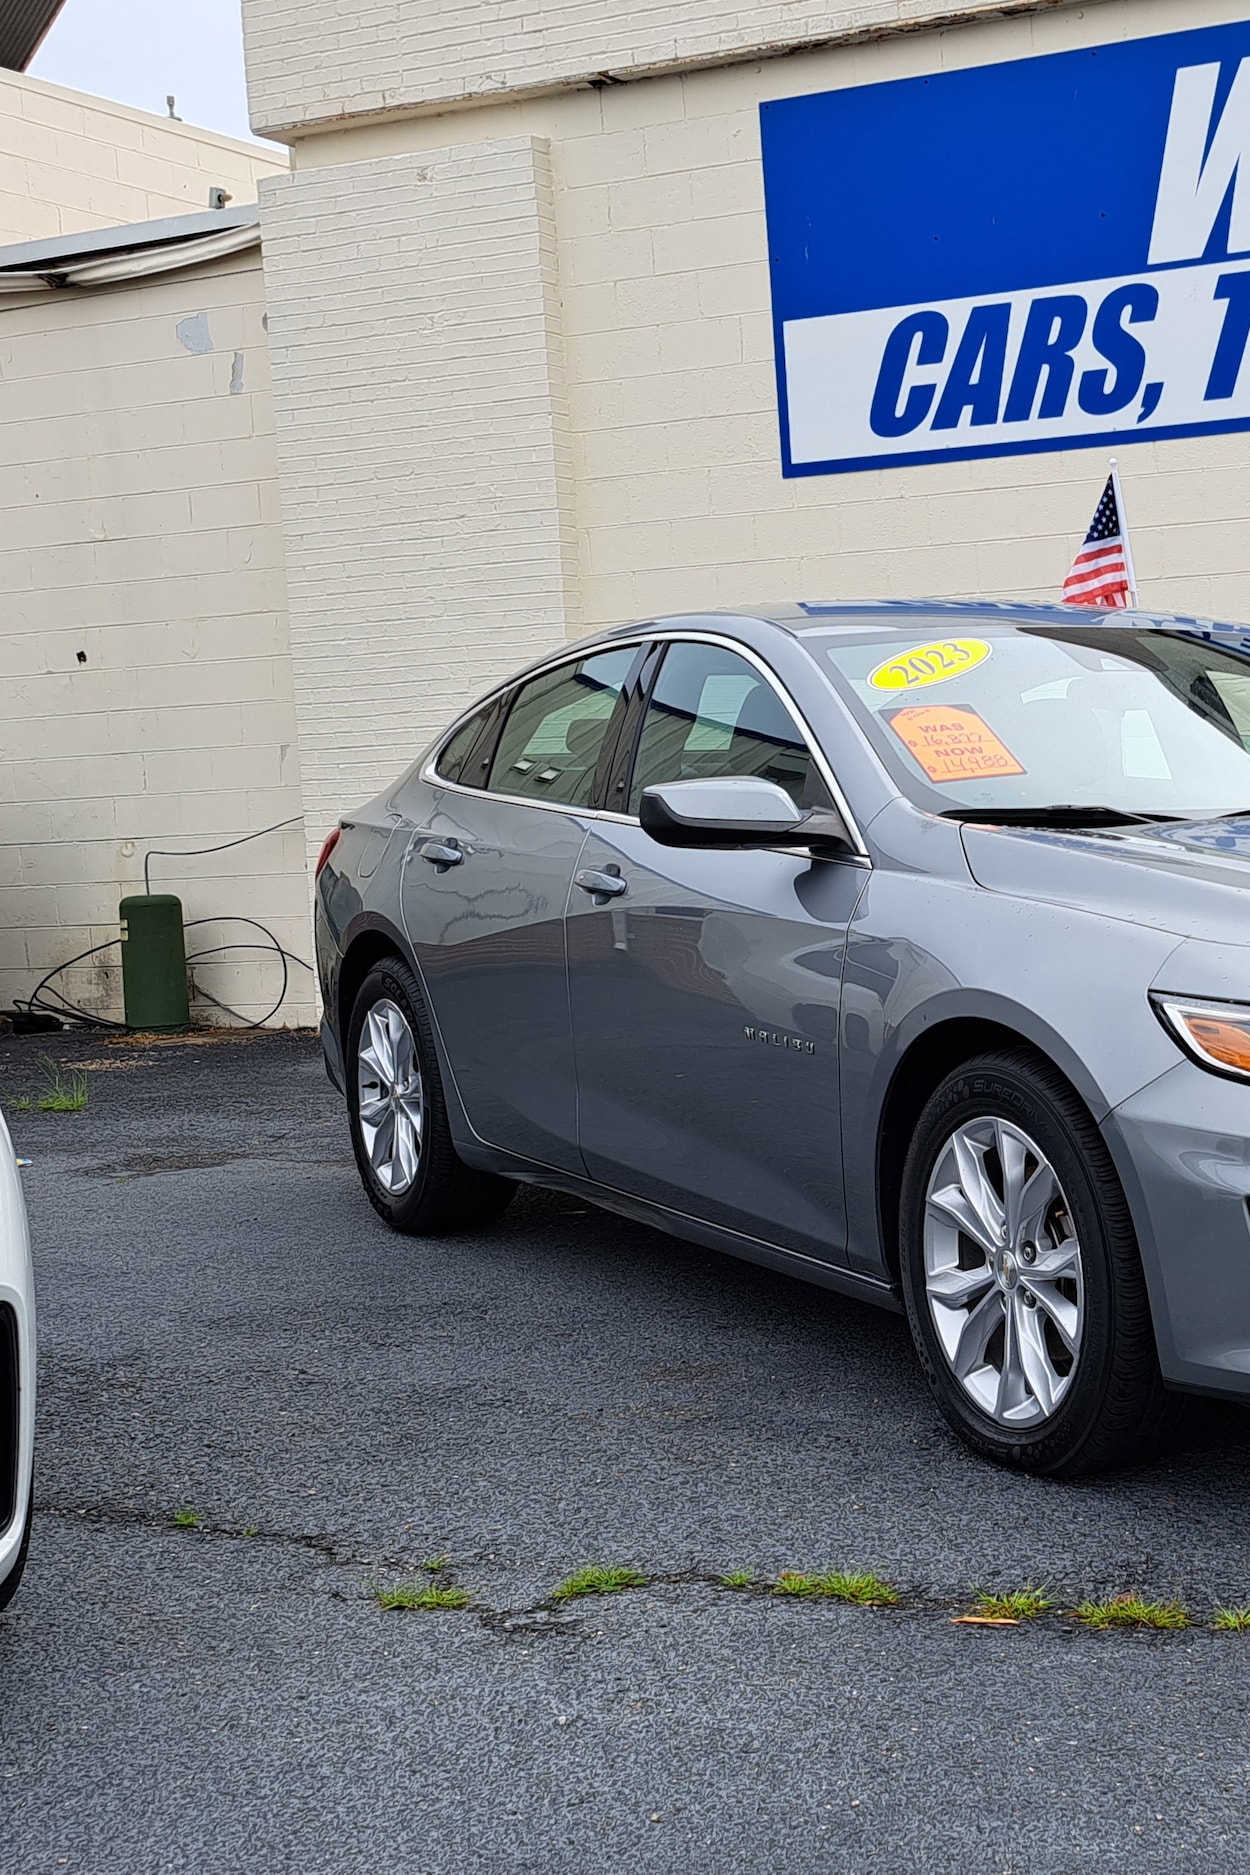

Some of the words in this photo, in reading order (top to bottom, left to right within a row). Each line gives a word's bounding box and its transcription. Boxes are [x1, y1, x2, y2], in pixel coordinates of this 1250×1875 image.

[870, 283, 1164, 437] CARS,
[890, 643, 970, 684] 2023
[919, 723, 965, 733] WAS
[934, 746, 984, 757] NOW
[744, 1026, 815, 1055] MALIBU
